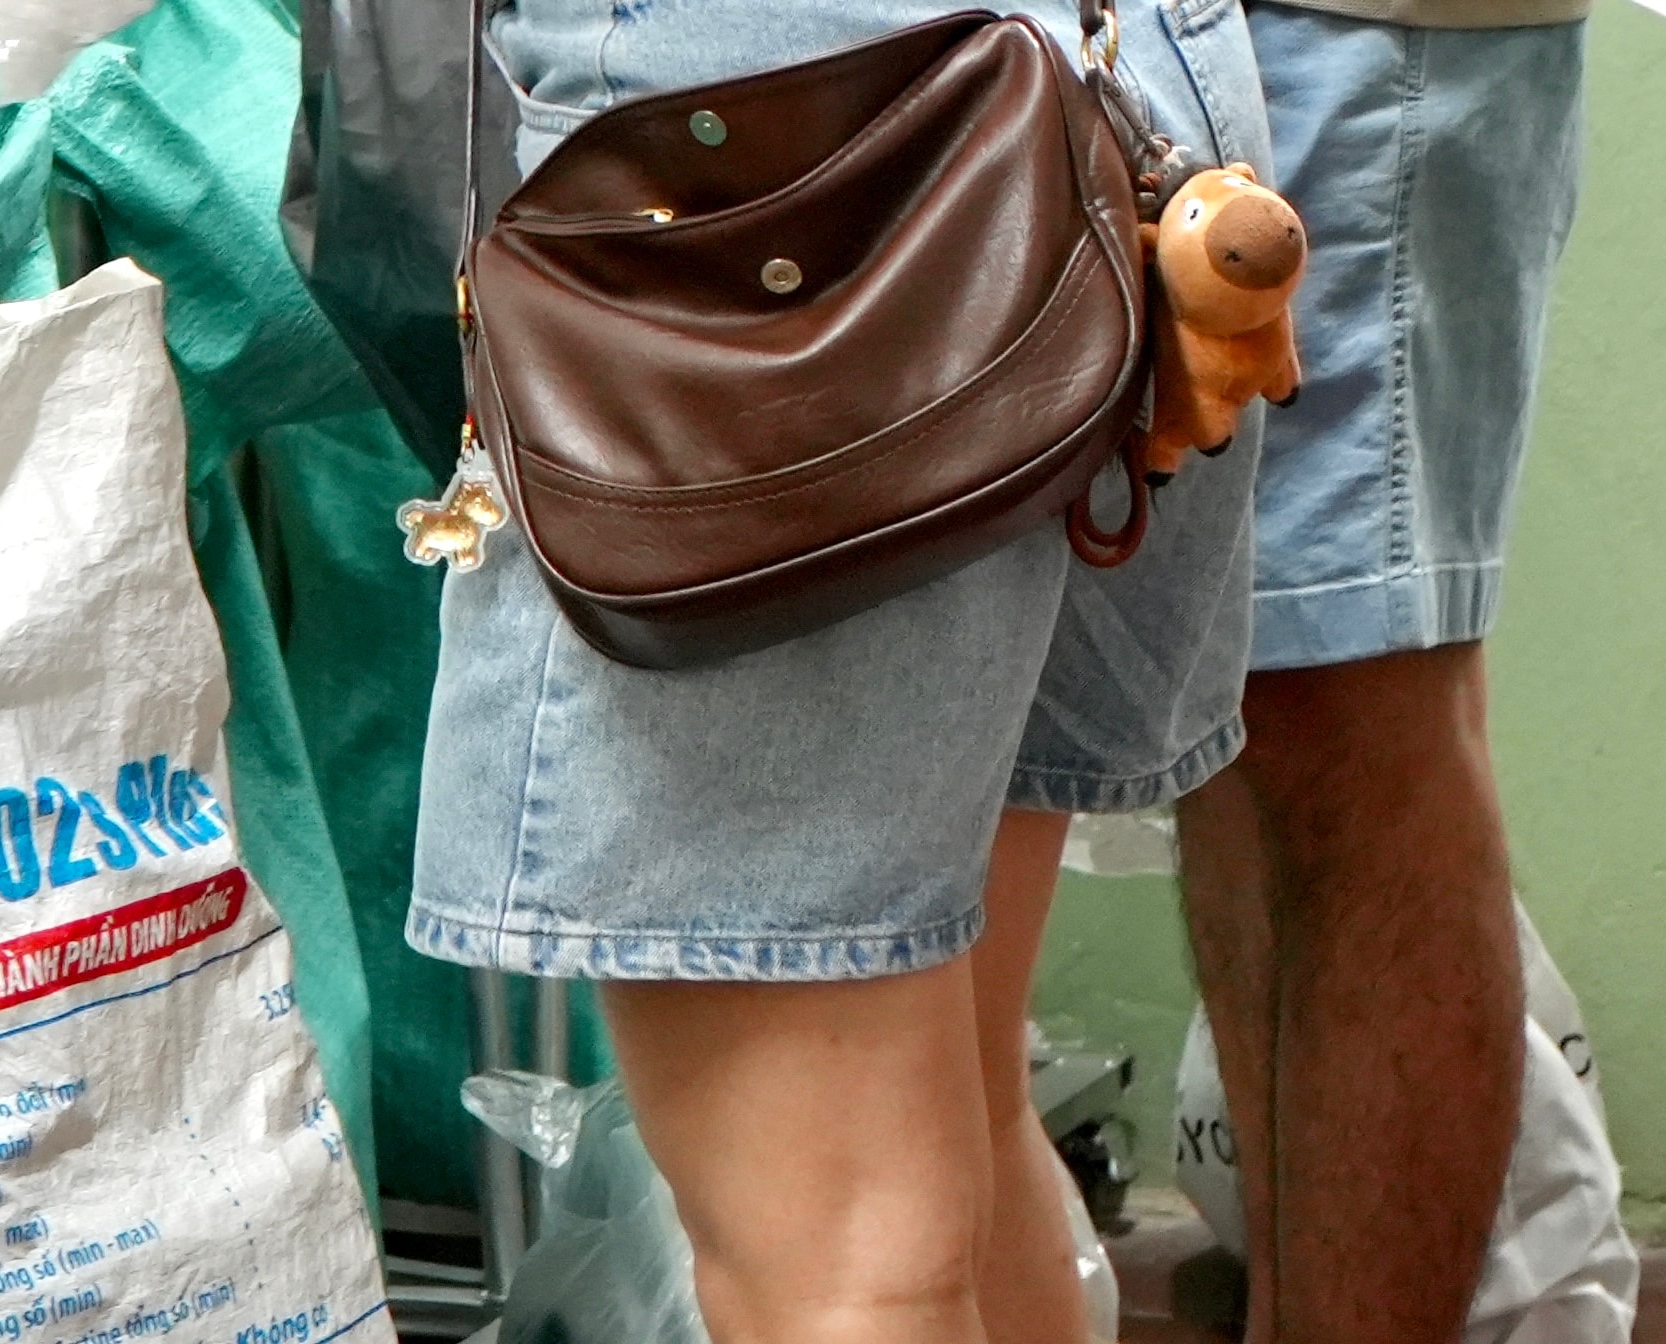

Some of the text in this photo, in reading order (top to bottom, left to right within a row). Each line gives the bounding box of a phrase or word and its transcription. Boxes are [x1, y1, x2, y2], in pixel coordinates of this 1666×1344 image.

[61, 915, 128, 978] PHẦN
[24, 1294, 47, 1329] số
[49, 1283, 104, 1323] (min)
